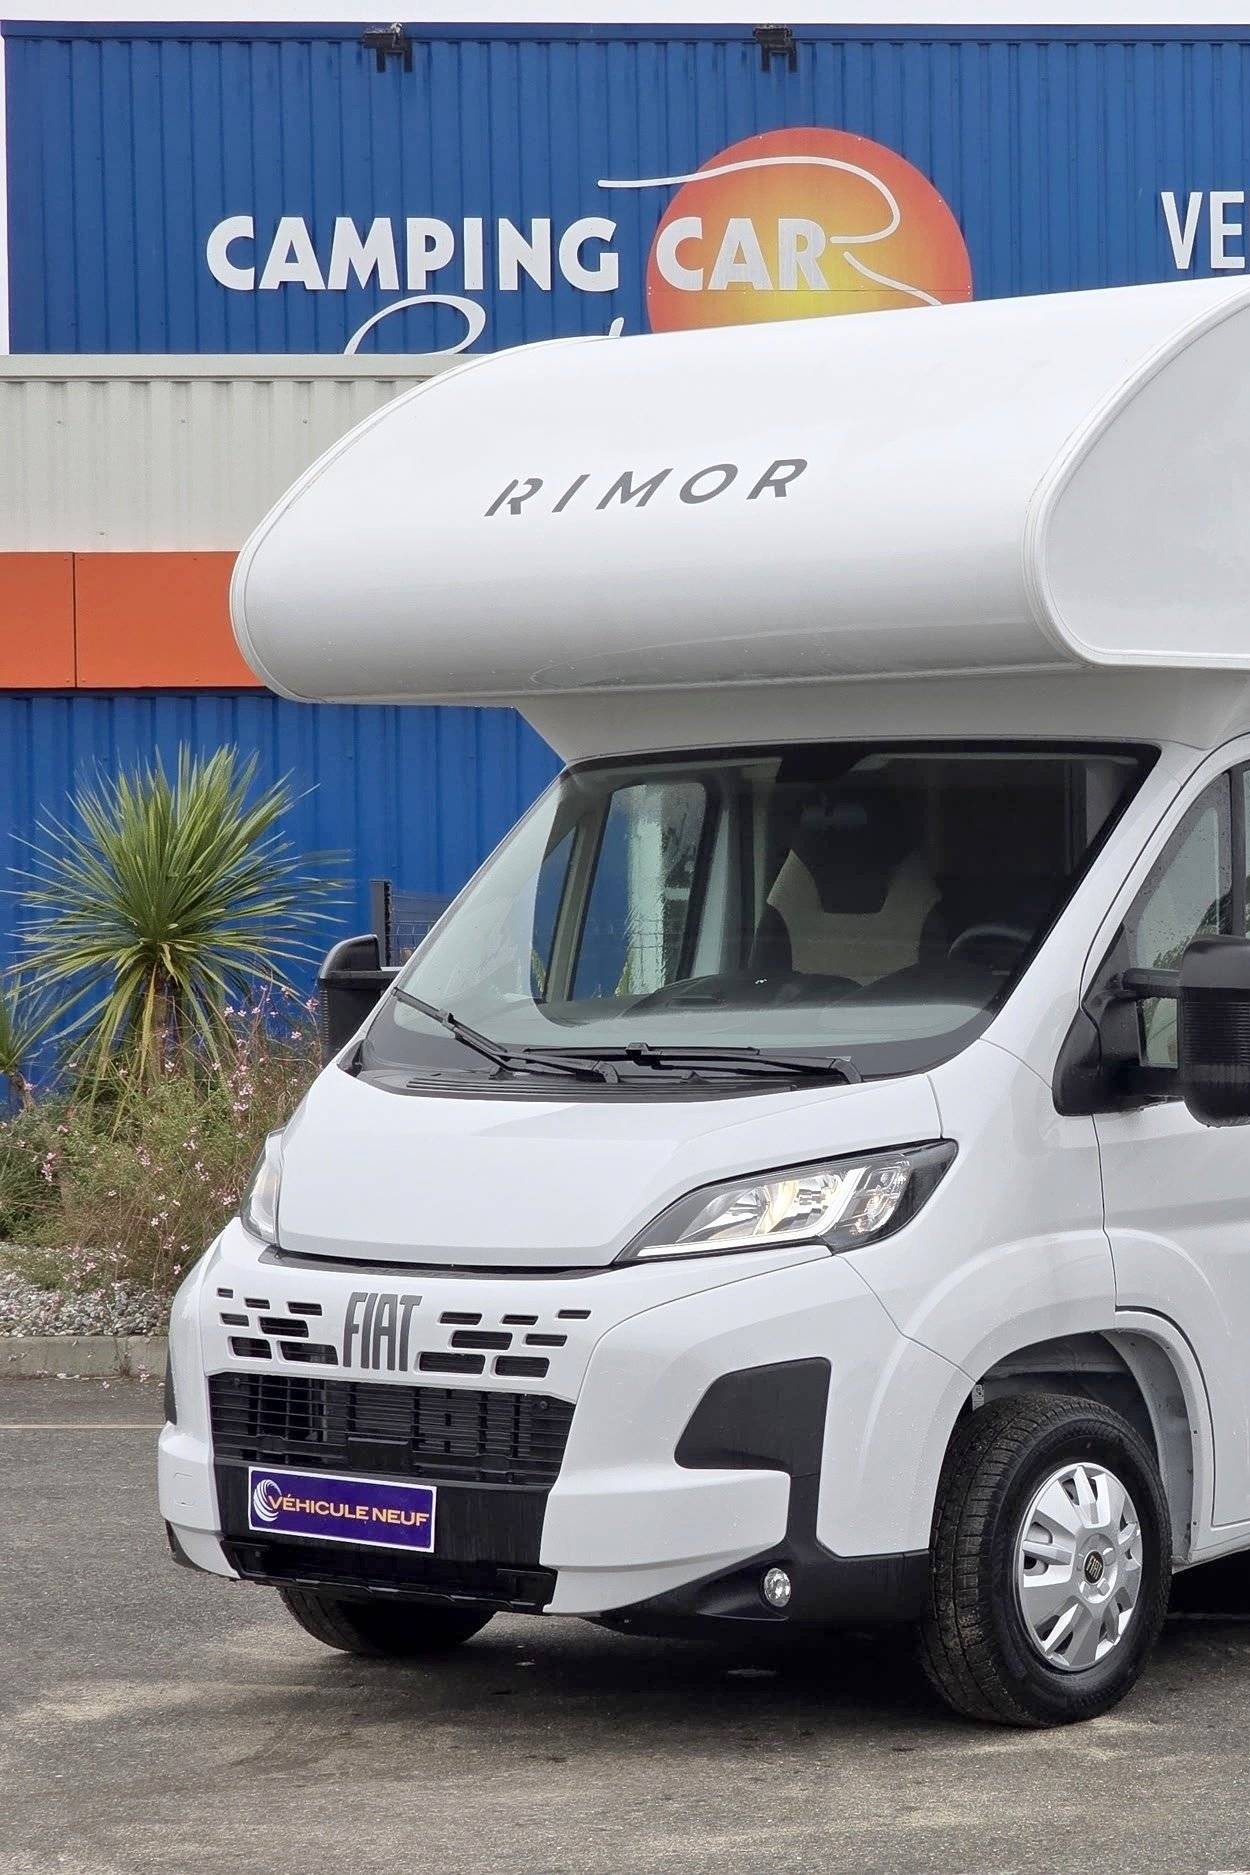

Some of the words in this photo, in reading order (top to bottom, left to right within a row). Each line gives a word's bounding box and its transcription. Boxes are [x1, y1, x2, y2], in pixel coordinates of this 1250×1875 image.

[206, 215, 619, 292] CAMPING
[656, 215, 832, 292] CAR
[484, 458, 808, 517] RIMOR
[343, 1291, 423, 1372] FIAT
[268, 1494, 370, 1520] VÉHICULE
[371, 1507, 430, 1527] NEUF
